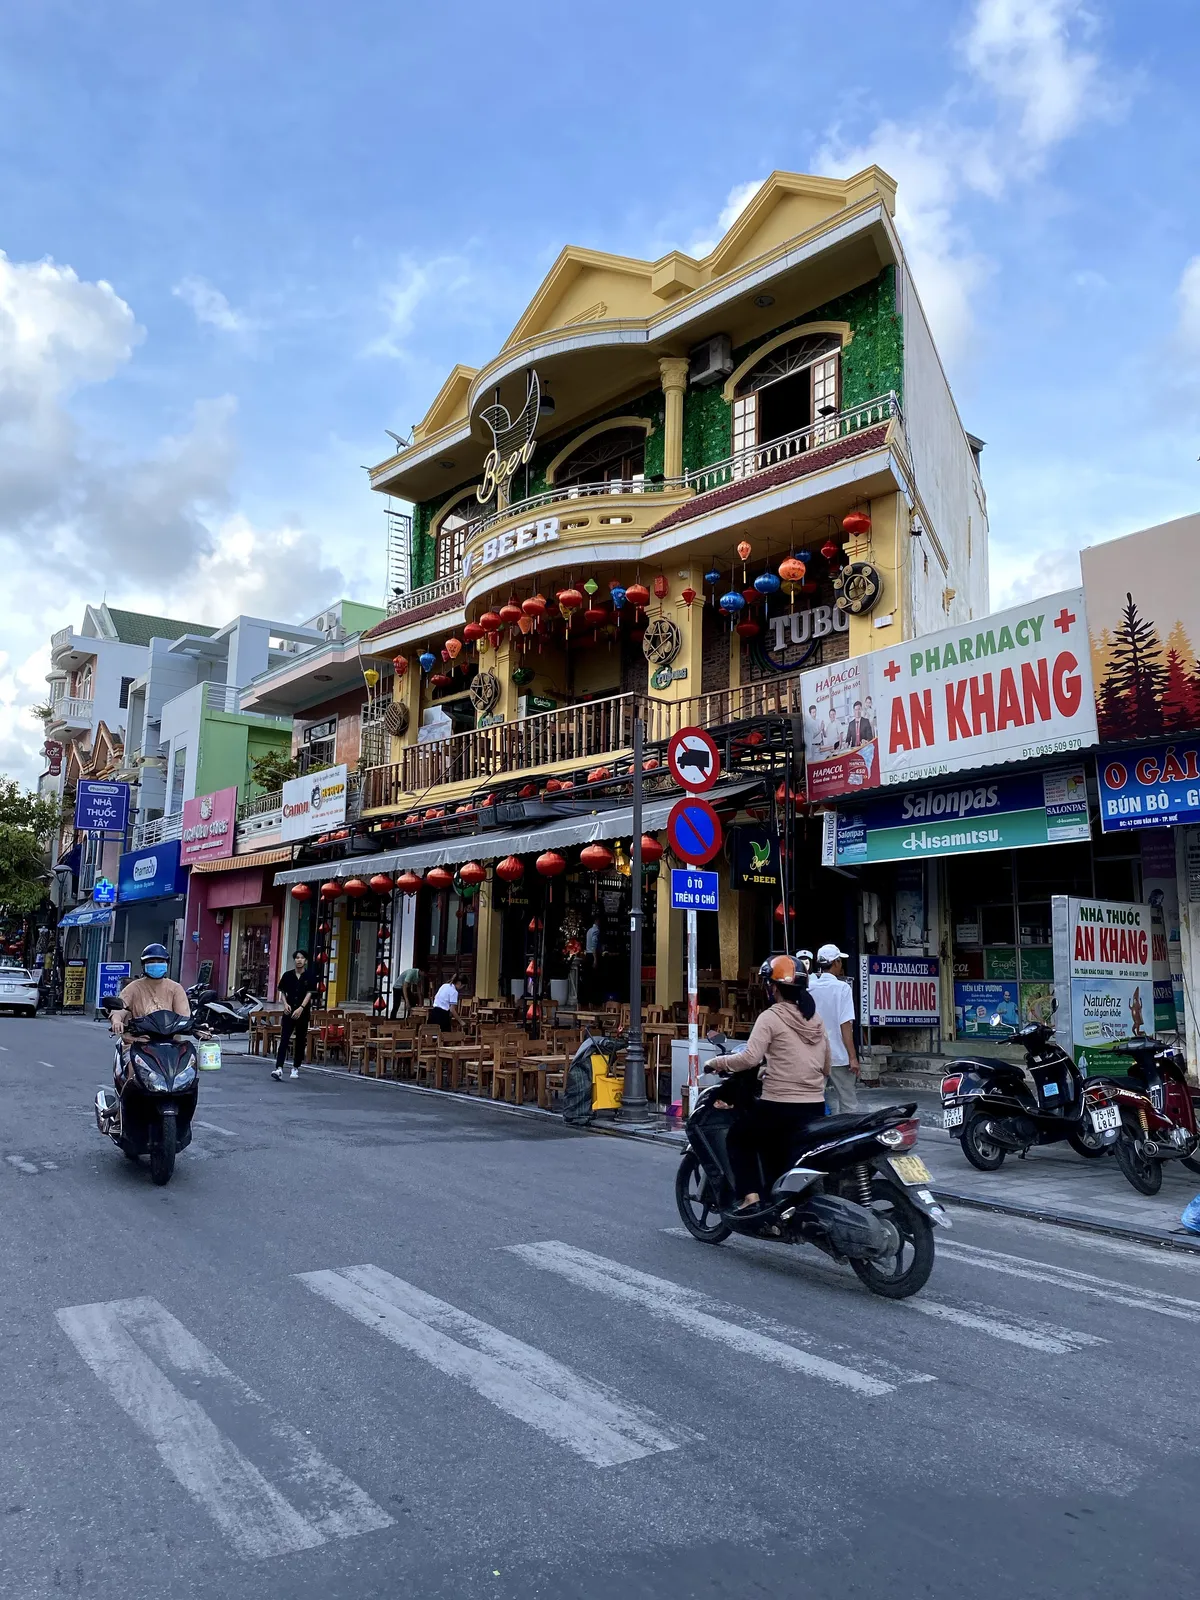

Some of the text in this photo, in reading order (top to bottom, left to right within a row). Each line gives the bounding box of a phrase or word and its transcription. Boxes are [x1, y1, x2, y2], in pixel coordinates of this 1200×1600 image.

[476, 440, 537, 504] Beer
[462, 517, 560, 578] V-BEER
[910, 614, 1045, 677] PHARMACY
[815, 665, 861, 693] HAPACOL
[889, 651, 1082, 754] AN KHANG
[1036, 744, 1052, 756] 0935
[1054, 741, 1067, 752] 509
[1068, 738, 1082, 749] 970
[812, 764, 844, 778] HAPACOL
[901, 772, 909, 781] 47
[909, 769, 922, 779] CHU
[939, 764, 948, 774] AN
[1104, 746, 1200, 790] O GÁI
[92, 797, 112, 806] NHÀ
[282, 801, 310, 819] Canon
[902, 785, 999, 819] Salonpas
[1046, 803, 1087, 815] SALONPAS
[1107, 794, 1142, 816] BÚN
[1146, 789, 1169, 811] BÒ
[1187, 788, 1200, 807] G
[87, 807, 117, 818] THUỐC
[92, 818, 109, 827] TÂY
[837, 829, 864, 839] Salonpas
[902, 828, 999, 850] Hisamitsu
[826, 841, 834, 857] NHÀ
[687, 876, 703, 889] Ô TÔ
[742, 874, 776, 884] V-BEER
[675, 890, 716, 904] TRÊN 9 CHỖ
[1080, 904, 1104, 923] NHÀ
[1106, 907, 1140, 926] THUỐC
[1074, 925, 1148, 965] AN KHANG
[881, 962, 928, 974] PHARMACIE
[874, 980, 936, 1011] AN KHANG
[1083, 994, 1121, 1008] Naturenz
[1083, 1008, 1093, 1017] Cho
[1099, 1010, 1109, 1019] gan
[1095, 1107, 1115, 1121] 75-H9
